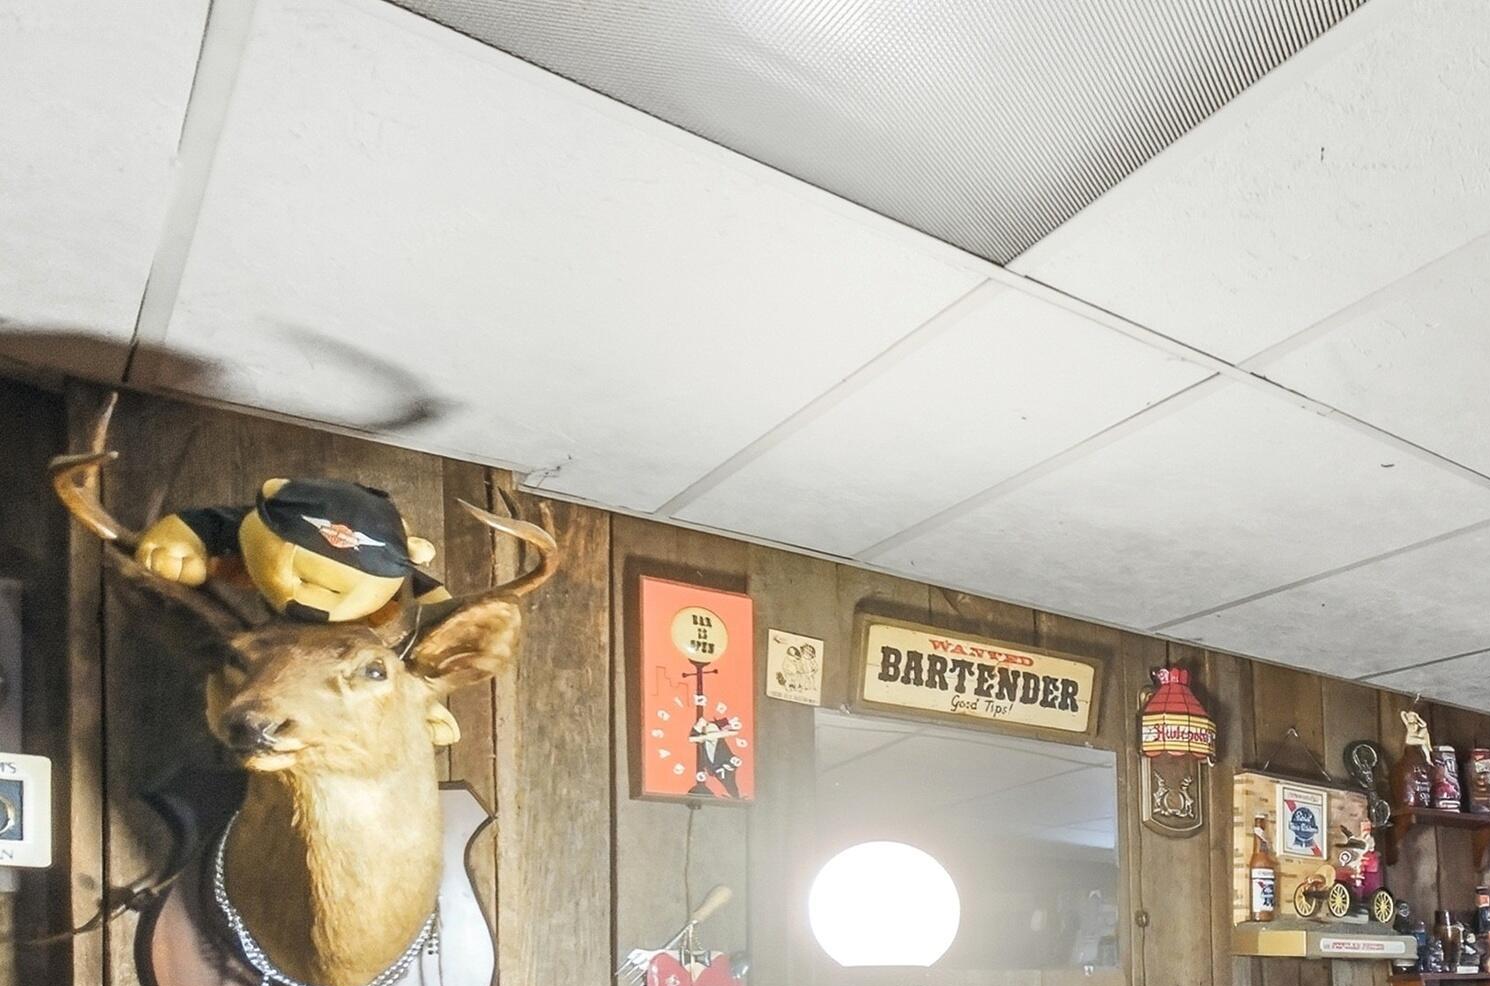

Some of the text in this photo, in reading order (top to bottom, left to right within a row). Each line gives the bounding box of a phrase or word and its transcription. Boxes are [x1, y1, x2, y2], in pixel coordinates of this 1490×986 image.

[692, 614, 712, 628] BAR
[697, 628, 708, 640] IS
[690, 639, 715, 654] OPEN
[928, 639, 1034, 668] WANTED
[877, 645, 1079, 713] BARTENDER
[985, 700, 1014, 718] Tips!
